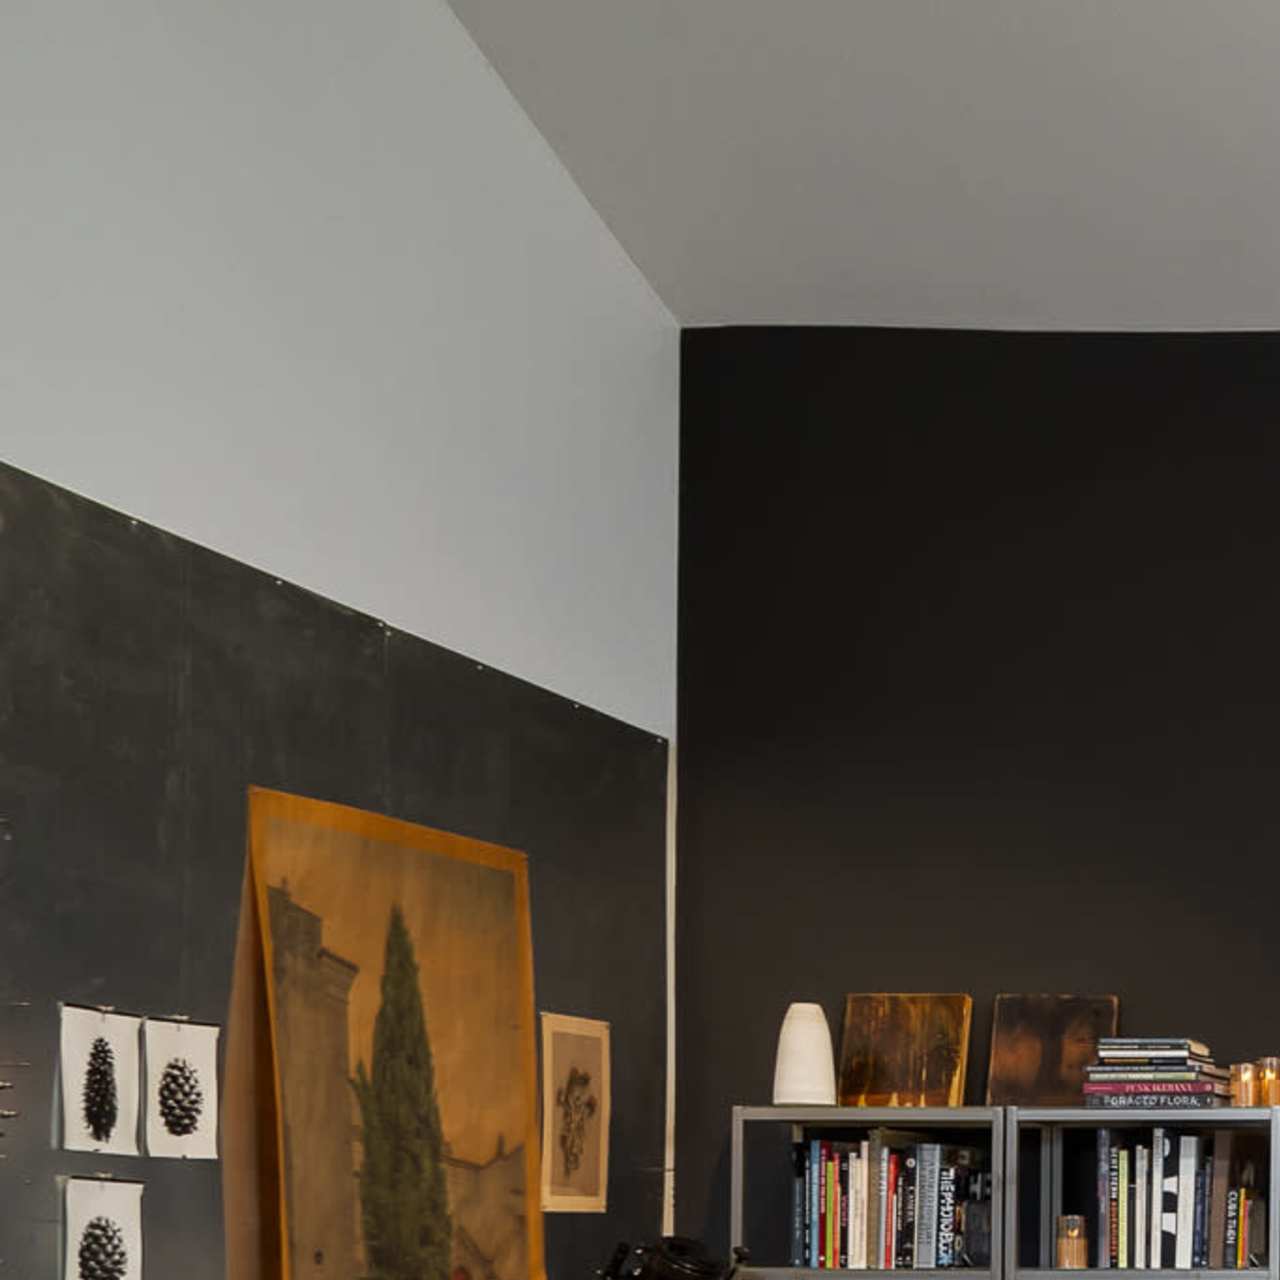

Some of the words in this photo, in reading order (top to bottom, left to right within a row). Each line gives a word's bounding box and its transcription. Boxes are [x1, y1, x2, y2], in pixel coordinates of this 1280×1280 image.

[1160, 1096, 1199, 1106] FLORA
[1110, 1171, 1118, 1198] STERN
[1227, 1190, 1238, 1217] CUBA
[1226, 1219, 1237, 1244] THEN
